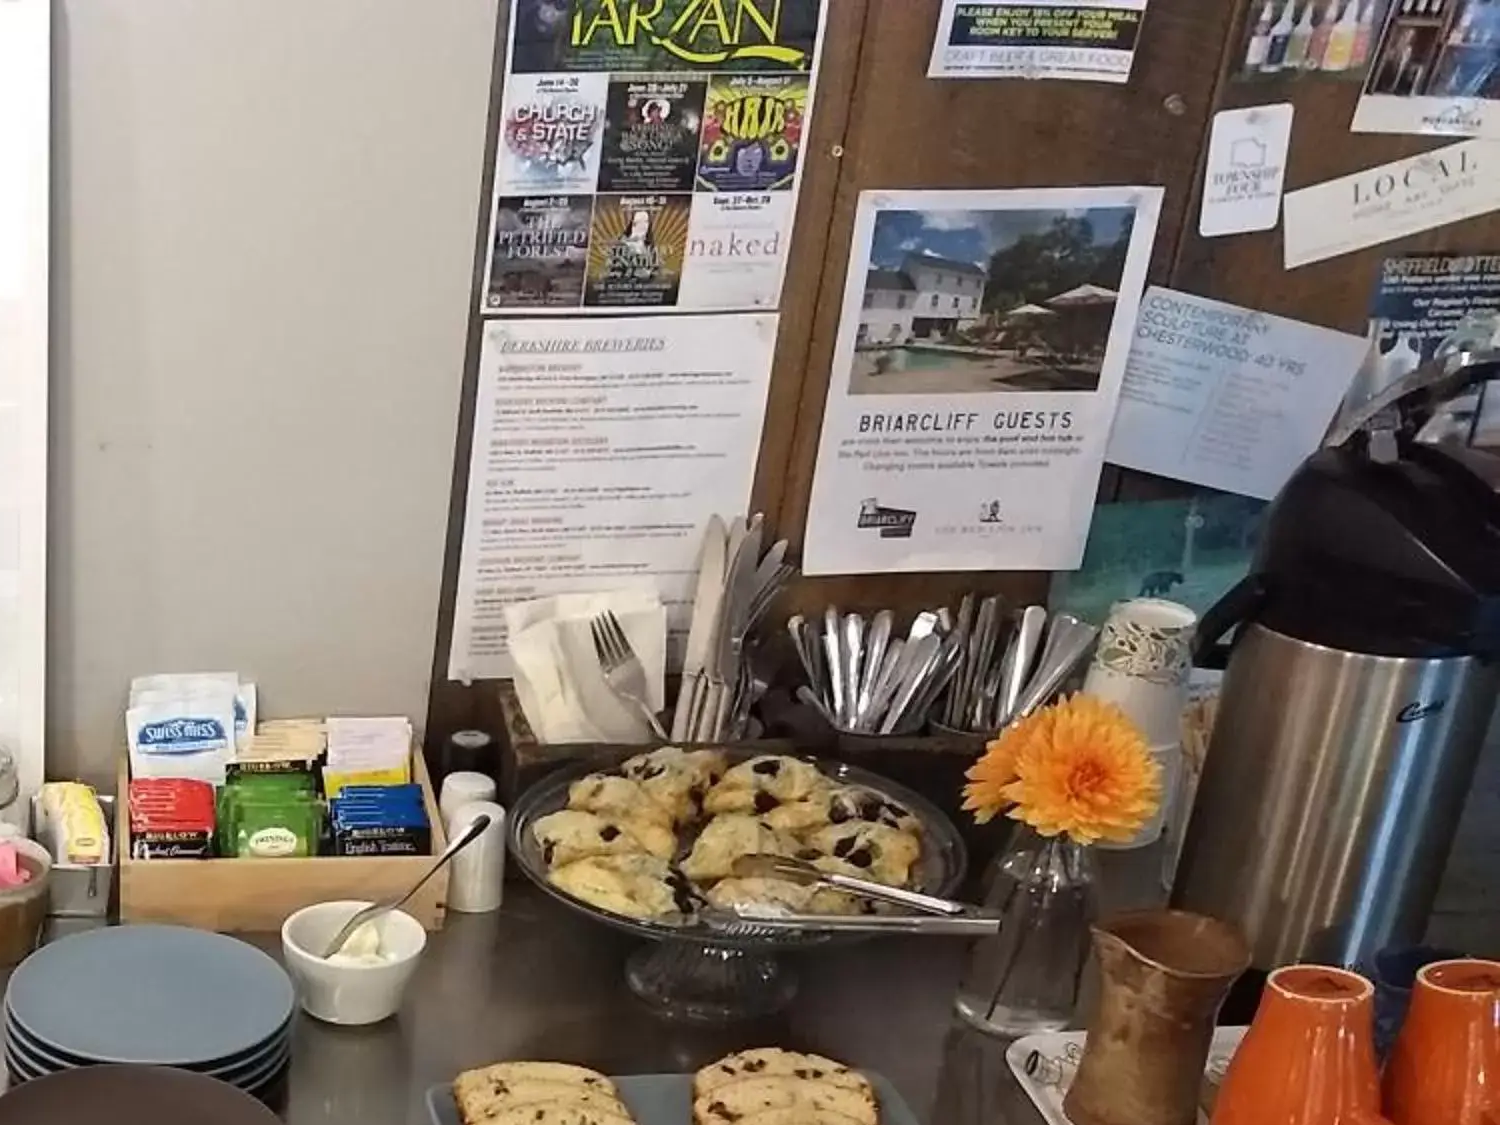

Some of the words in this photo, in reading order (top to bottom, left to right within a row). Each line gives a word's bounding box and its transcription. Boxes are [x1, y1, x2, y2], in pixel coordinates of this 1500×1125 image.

[515, 104, 596, 123] CHURCH
[532, 122, 590, 142] STATE
[1352, 150, 1479, 205] LOCAL
[507, 244, 571, 259] FOREST
[689, 230, 780, 257] naked
[1383, 257, 1449, 275] SHEFFIELD
[1149, 296, 1270, 334] CONTEMPORARY
[1141, 311, 1228, 342] SCULPTURE
[500, 339, 580, 353] BERKSHIRE
[584, 336, 666, 352] BREWERIES
[859, 412, 979, 432] BRIARCLIFF
[993, 411, 1073, 429] GUESTS
[1020, 434, 1039, 442] and
